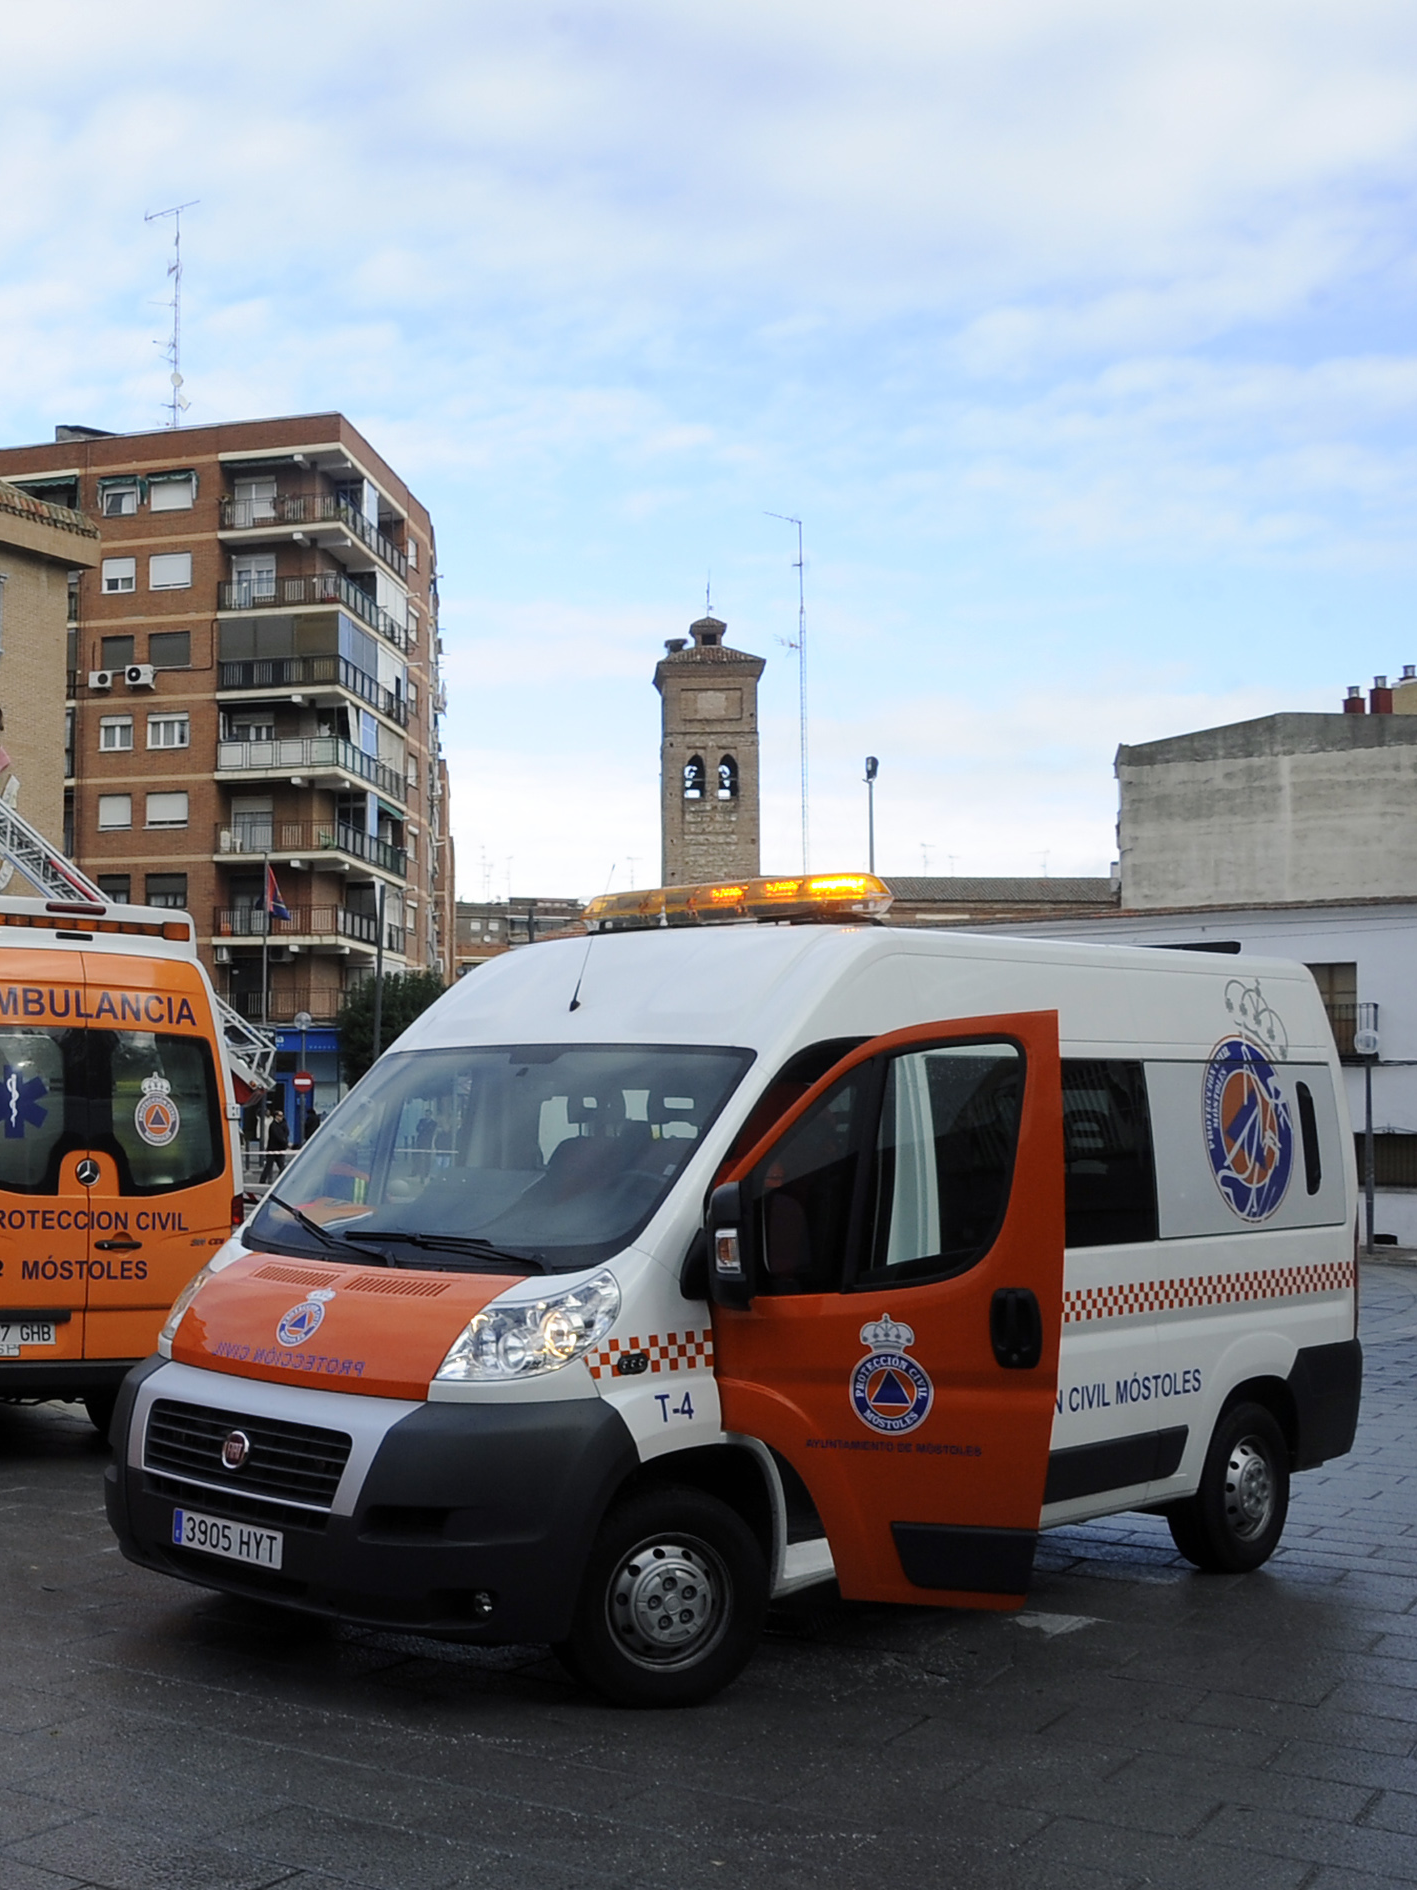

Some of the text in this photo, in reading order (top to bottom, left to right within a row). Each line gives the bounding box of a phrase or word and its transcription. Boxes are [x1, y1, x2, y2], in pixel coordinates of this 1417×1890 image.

[136, 1211, 189, 1231] CIVIL
[22, 1255, 148, 1280] MÓSTOLES
[20, 1324, 51, 1341] GHB
[855, 1354, 928, 1400] PROTECCIÓN CIVIL
[1069, 1383, 1110, 1412] CIVIL
[1115, 1368, 1201, 1405] MÓSTOLES
[654, 1391, 694, 1422] T-4
[863, 1409, 919, 1430] MÓSTOLES
[805, 1438, 894, 1452] AYUNTAMIENTO
[897, 1442, 912, 1453] DE
[186, 1516, 278, 1563] 3905 HYT
